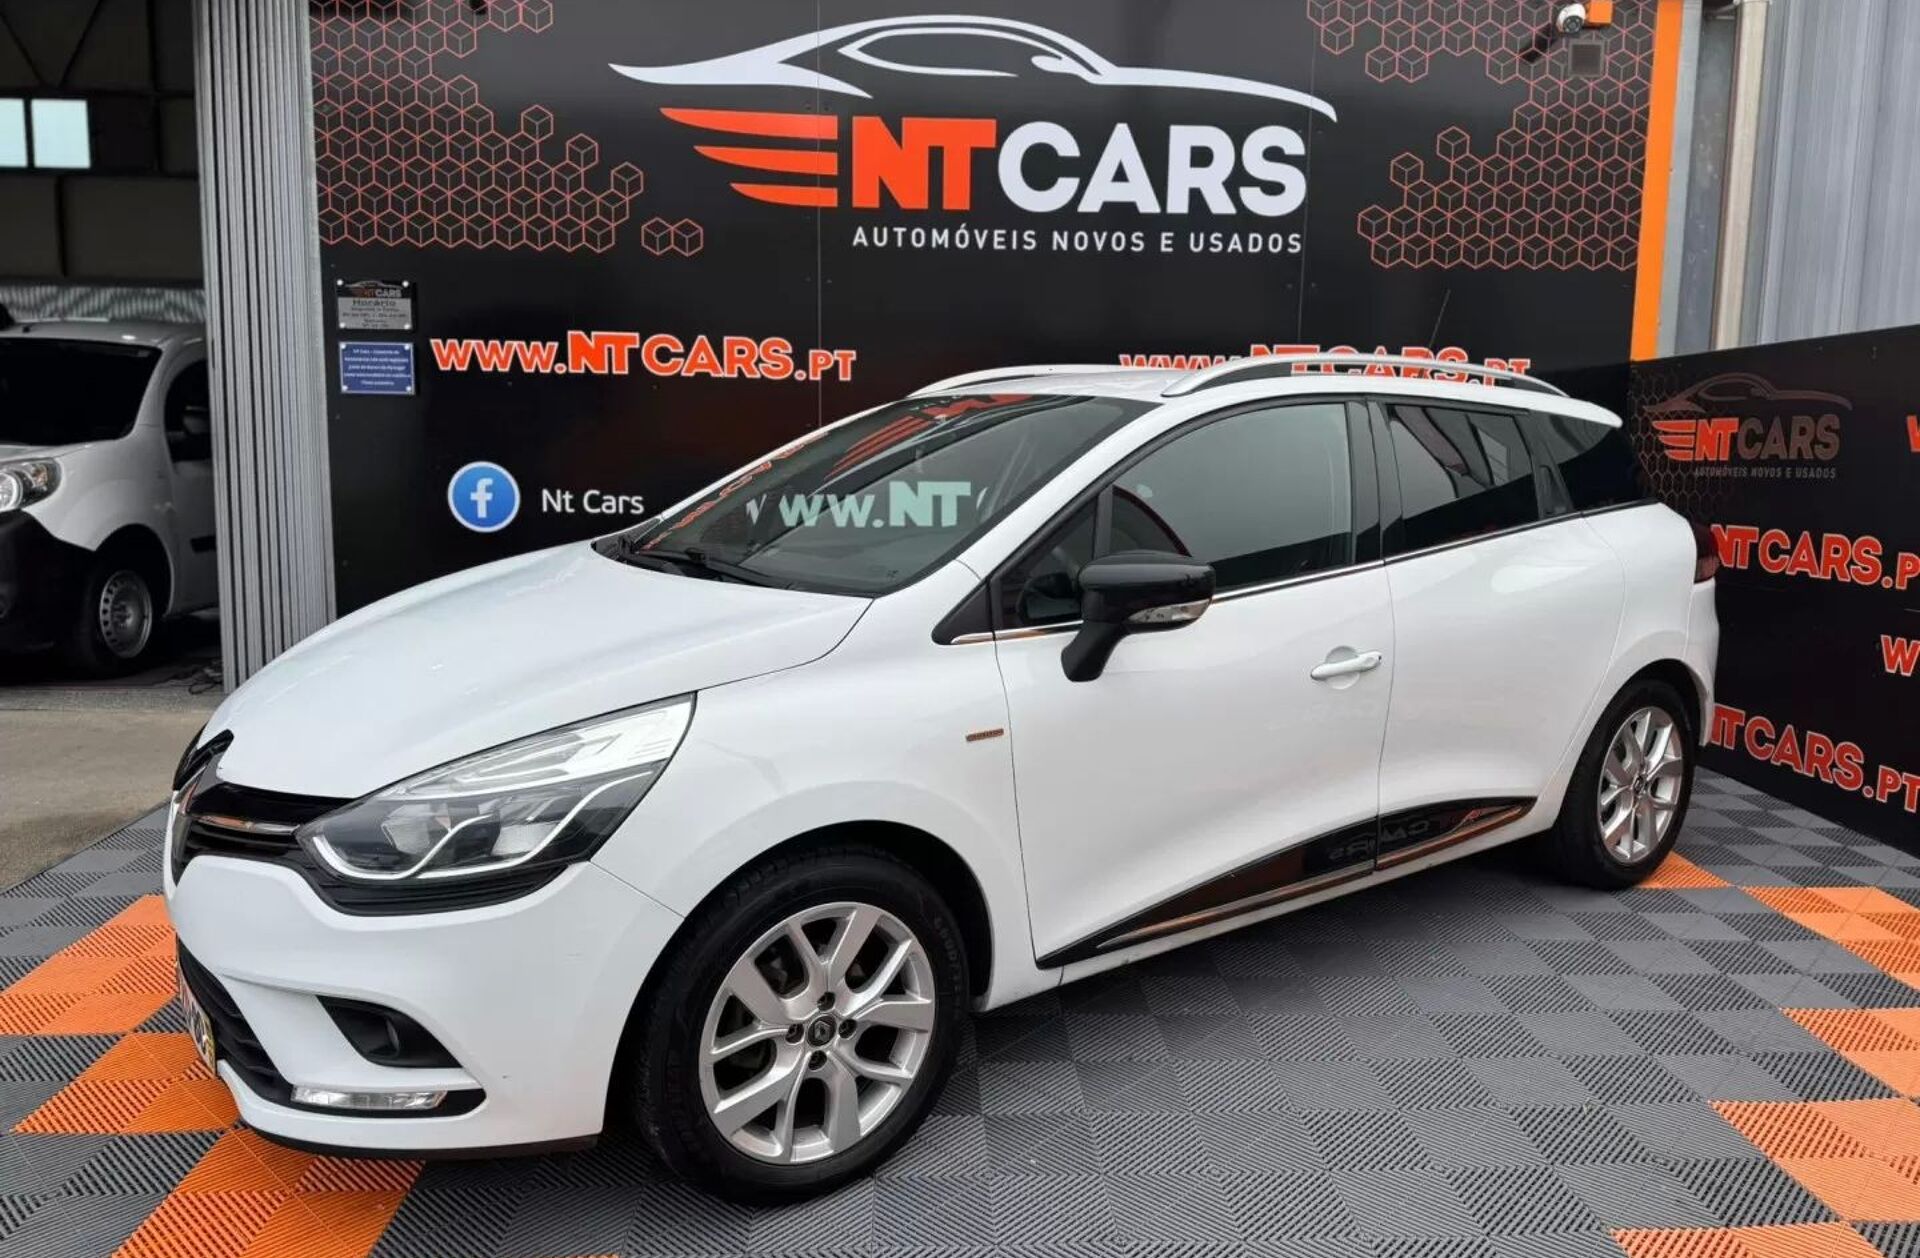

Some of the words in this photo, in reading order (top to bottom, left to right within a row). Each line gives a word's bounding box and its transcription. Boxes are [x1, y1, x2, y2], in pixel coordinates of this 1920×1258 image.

[852, 223, 1038, 251] AUTOMÓVEIS
[1052, 230, 1146, 252] NOVOS
[1160, 232, 1175, 252] E
[1189, 233, 1302, 254] USADOS
[430, 330, 857, 381] WWW.NTCARS.PT
[1751, 466, 1782, 478] NOVOS
[1785, 467, 1792, 478] E
[1795, 467, 1837, 479] USADOS
[541, 489, 576, 513] Nt
[583, 489, 645, 514] Cars
